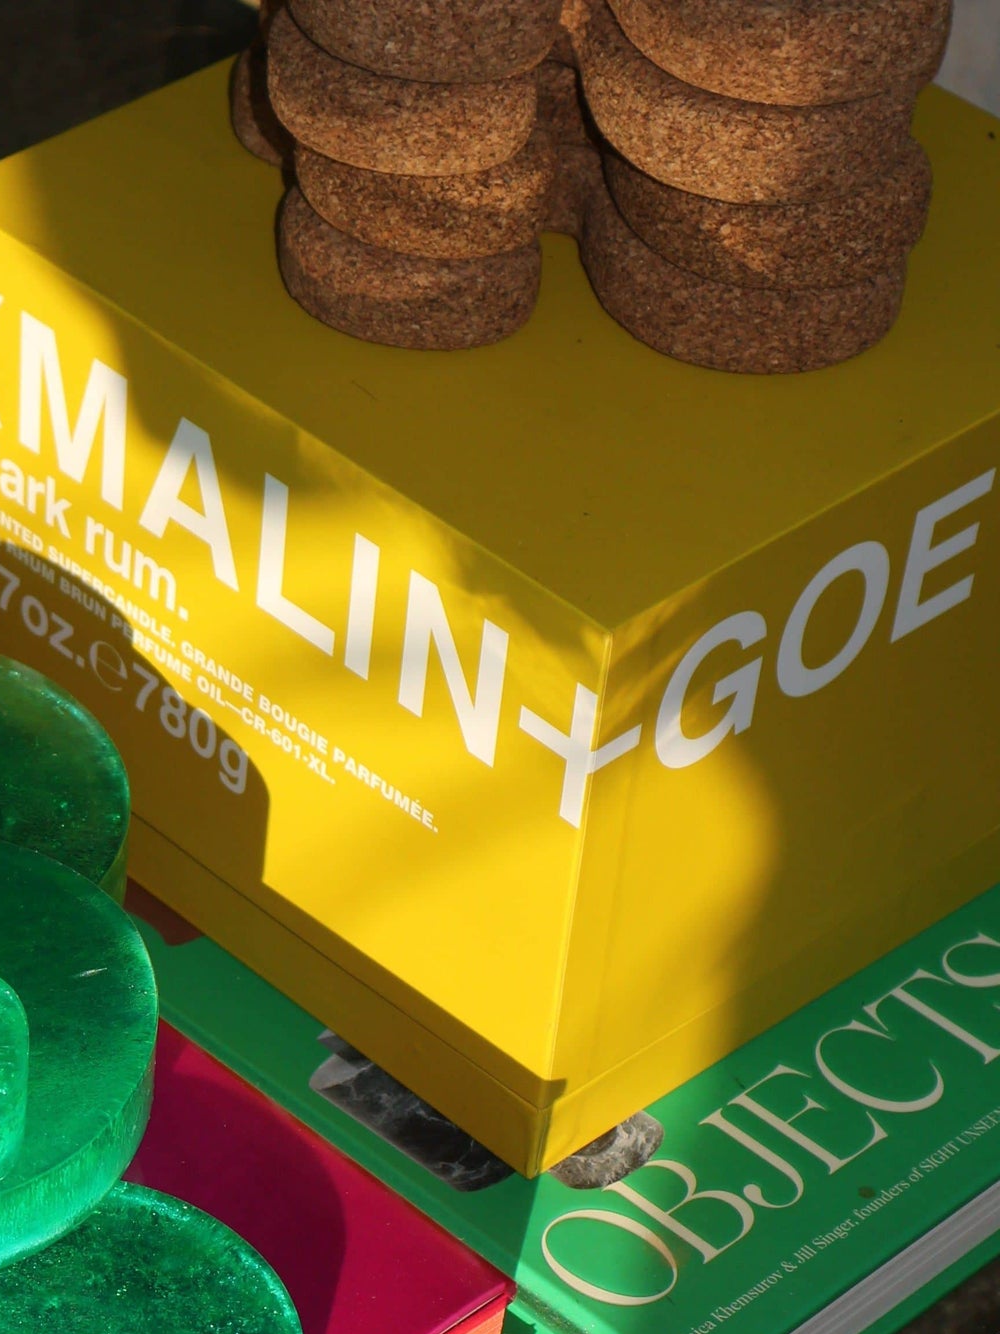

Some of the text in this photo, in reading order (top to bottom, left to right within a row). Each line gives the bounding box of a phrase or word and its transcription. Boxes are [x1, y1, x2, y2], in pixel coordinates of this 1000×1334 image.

[6, 539, 55, 584] RHUM
[60, 577, 107, 621] BRUN
[111, 613, 193, 683] PERFUME
[84, 515, 189, 622] rum.
[48, 545, 177, 648] SUPERCANDLE.
[180, 640, 255, 703] GRANDE
[258, 694, 329, 756] BOUGIE
[332, 746, 439, 834] PARFUMÉE.
[710, 1269, 784, 1324] Khemsurov
[780, 1260, 798, 1273] &
[793, 1244, 817, 1265] Jill
[812, 1218, 860, 1250] Singer,
[853, 1180, 911, 1221] founders
[908, 1167, 925, 1183] of
[919, 1141, 960, 1173] SIGHT
